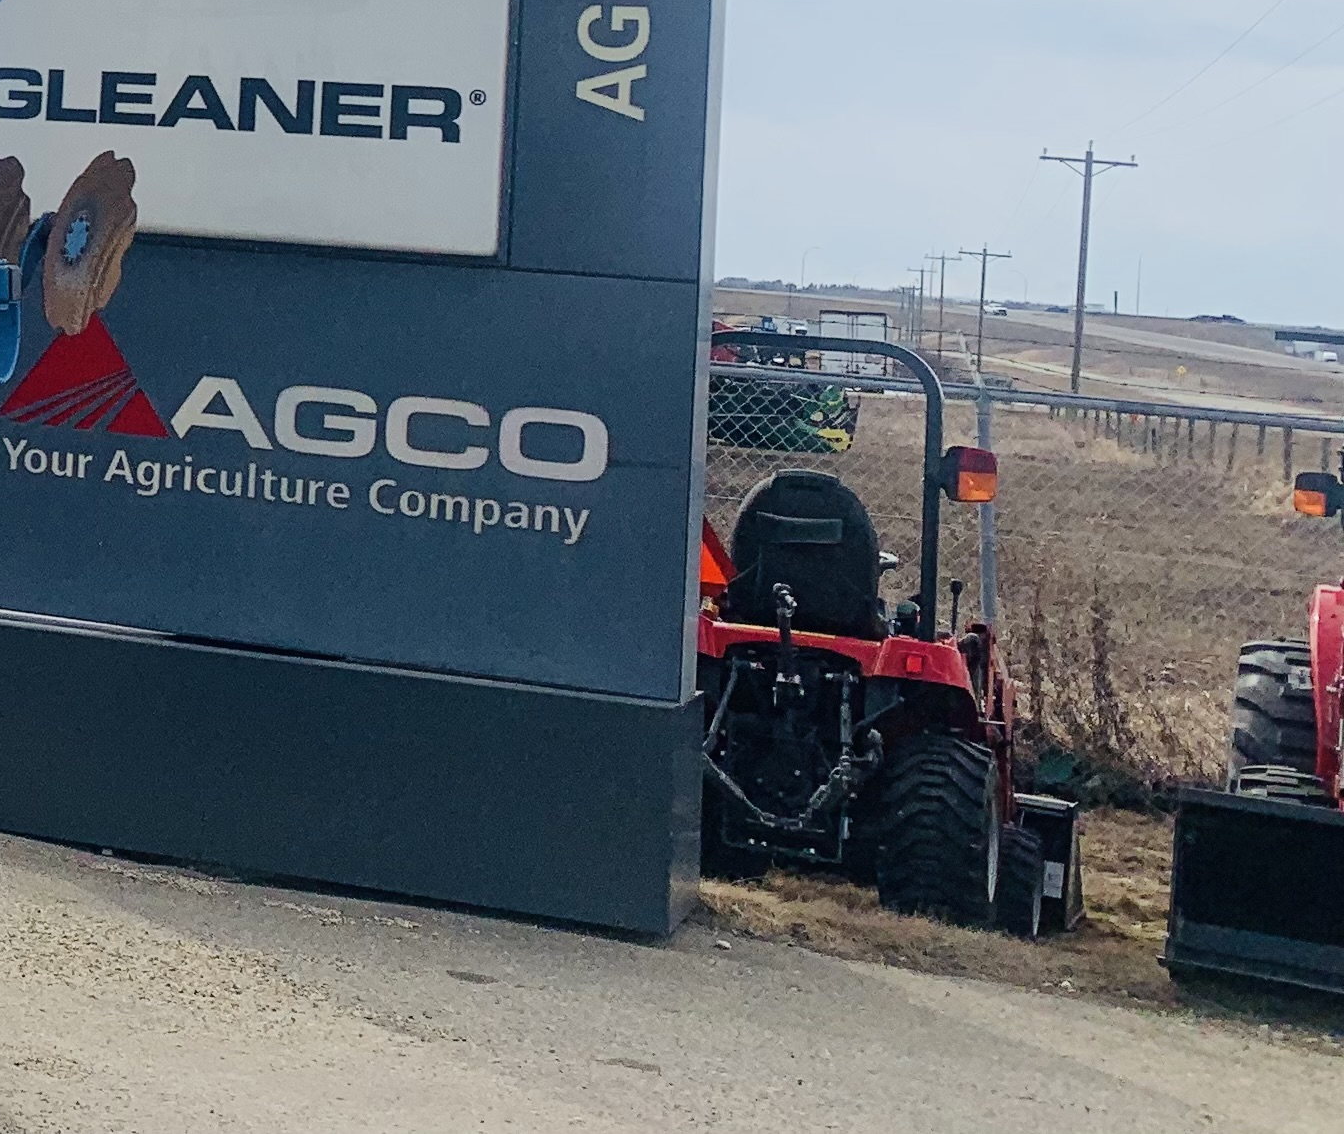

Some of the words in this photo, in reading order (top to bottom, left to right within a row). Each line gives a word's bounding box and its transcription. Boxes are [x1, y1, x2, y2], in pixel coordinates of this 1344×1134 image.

[169, 374, 610, 483] AGCO
[1, 436, 92, 481] Your
[103, 449, 351, 511] Agriculture
[369, 478, 591, 546] Company
